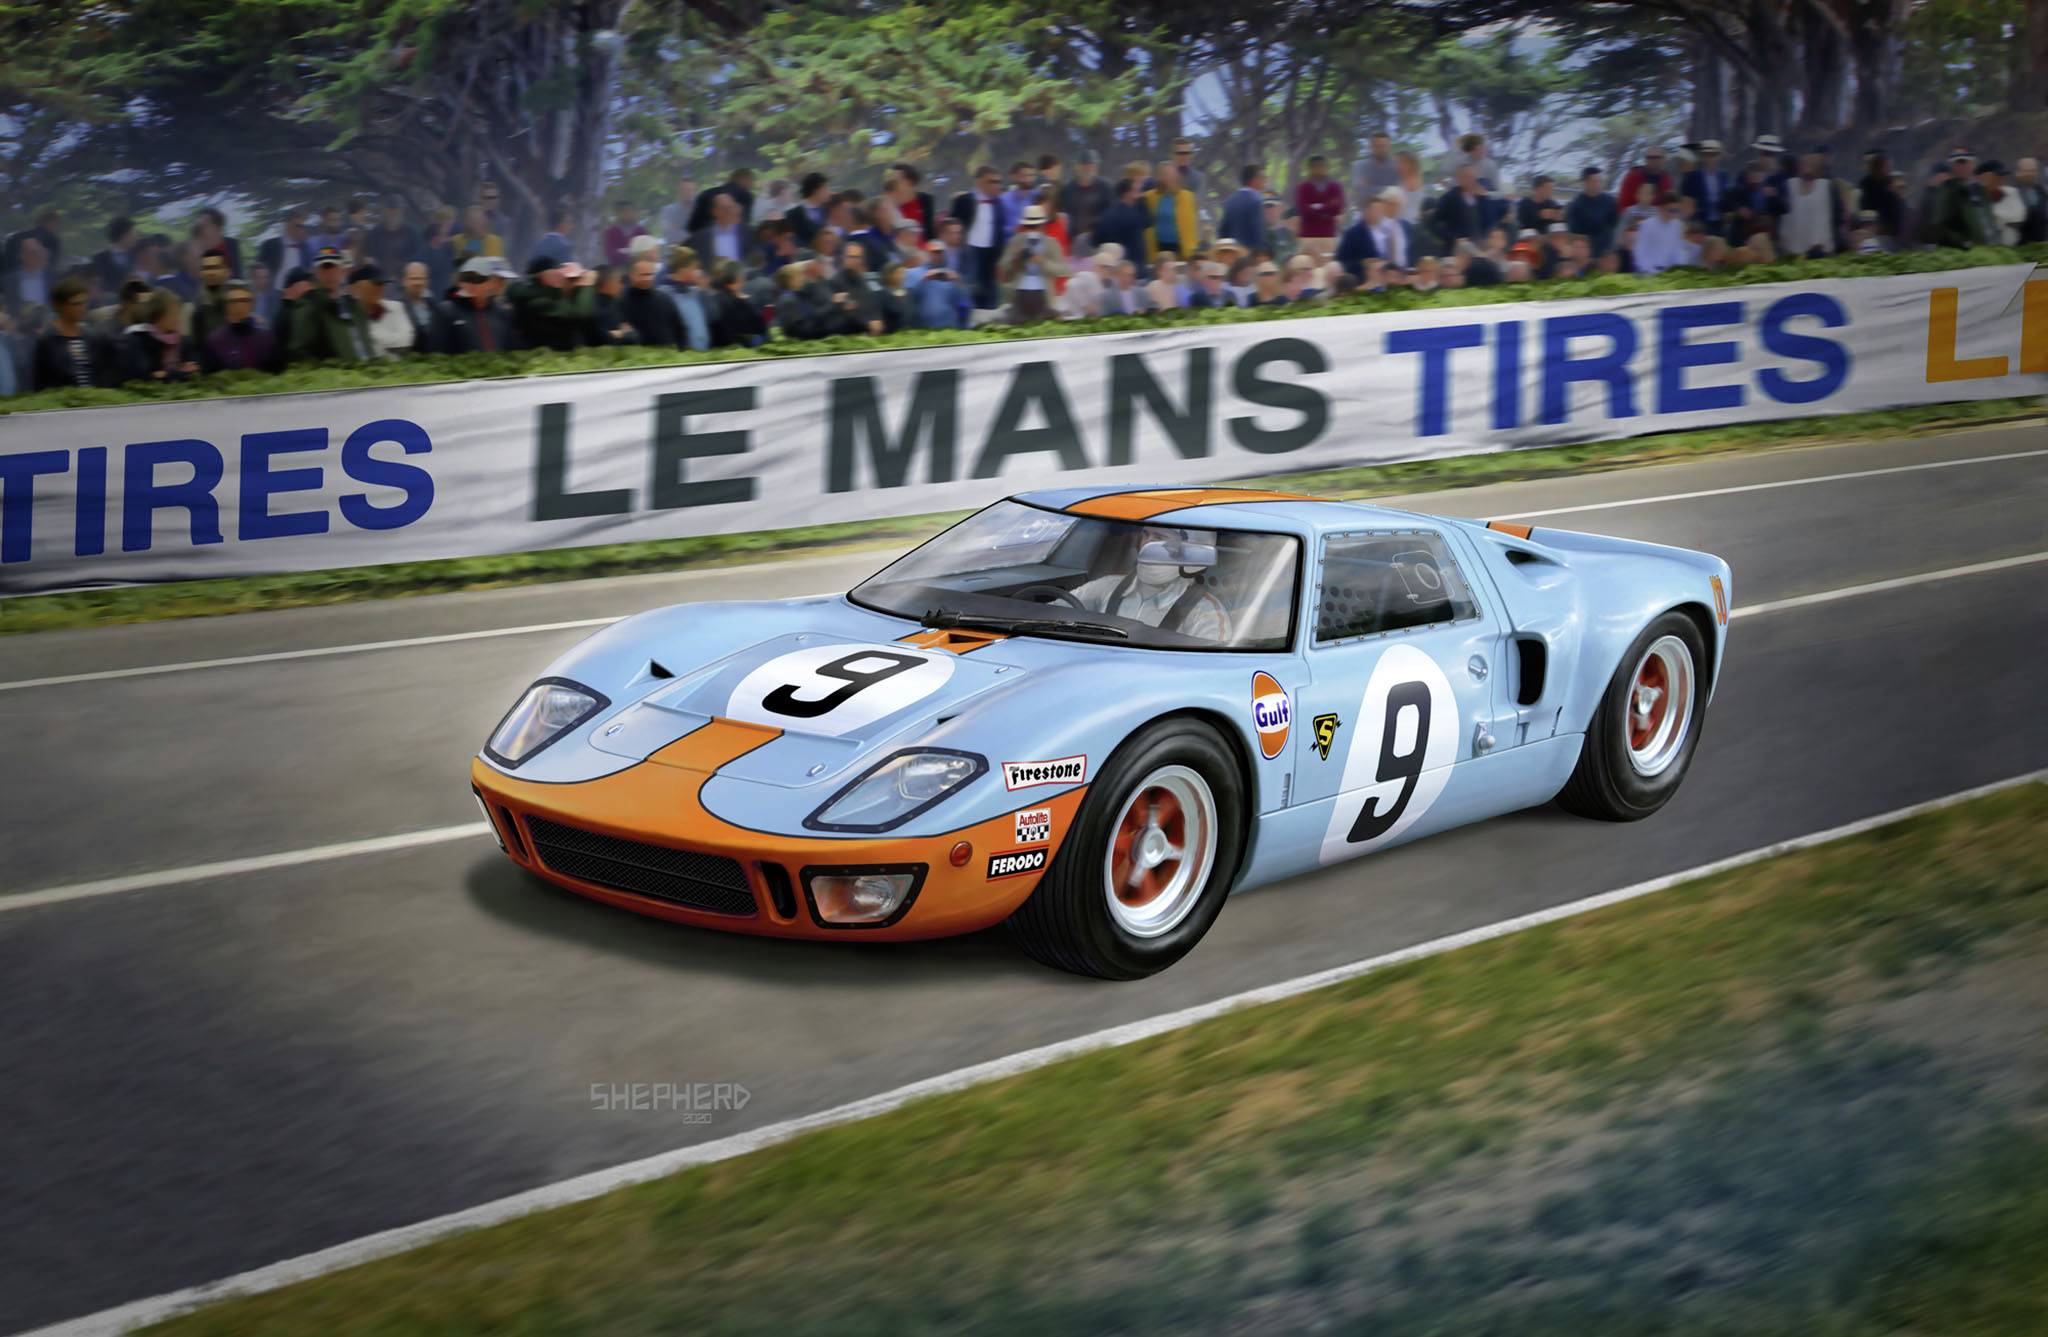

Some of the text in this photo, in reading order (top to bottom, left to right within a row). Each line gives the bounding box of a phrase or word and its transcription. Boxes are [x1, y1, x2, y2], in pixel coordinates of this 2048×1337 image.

[0, 418, 435, 563] TIRES
[530, 386, 759, 522] LE
[825, 337, 1333, 494] MANS
[1385, 292, 1857, 438] TIRES
[761, 649, 929, 719] 9
[1255, 699, 1289, 728] Gulf
[1009, 763, 1081, 785] Firestone
[1346, 680, 1432, 844] 9
[1019, 812, 1048, 827] Autolite
[991, 852, 1044, 876] FERODO
